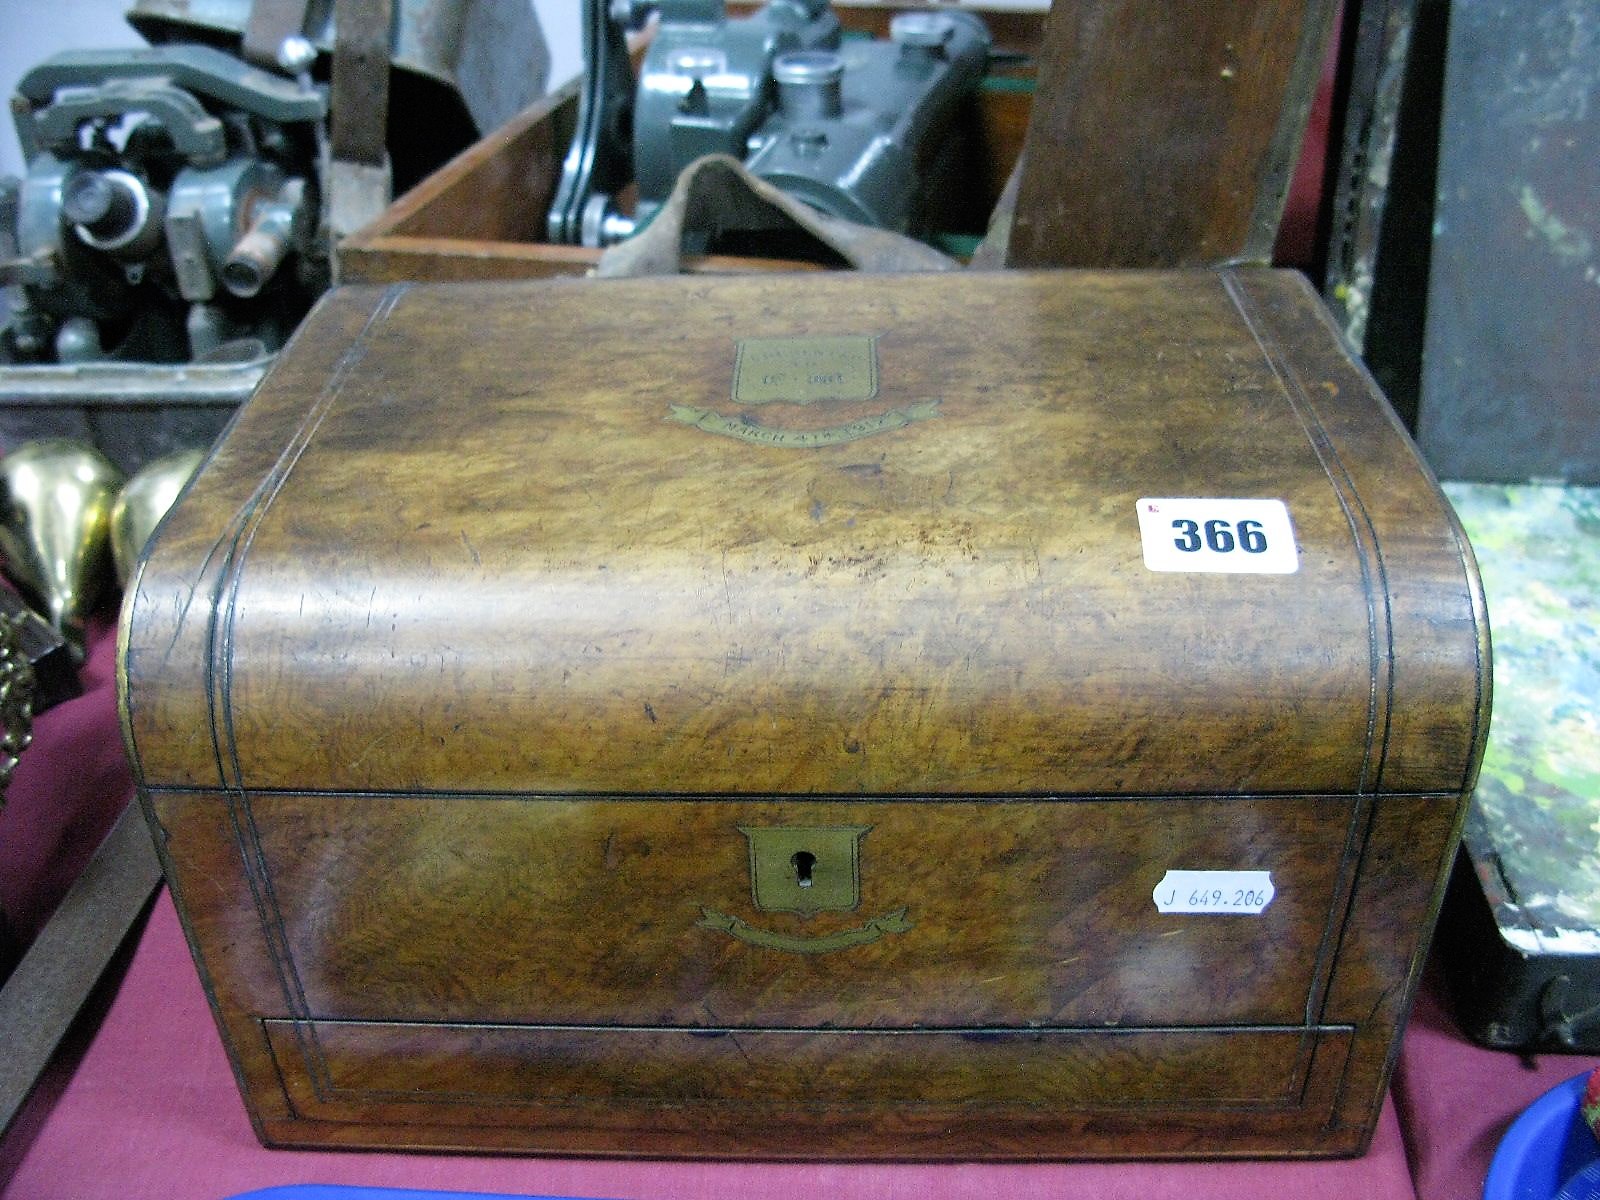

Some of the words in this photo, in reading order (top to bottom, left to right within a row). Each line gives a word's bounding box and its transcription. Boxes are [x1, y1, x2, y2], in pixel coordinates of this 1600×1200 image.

[1172, 519, 1268, 553] 366
[1164, 889, 1176, 906] J
[1188, 889, 1265, 906] 649.206
